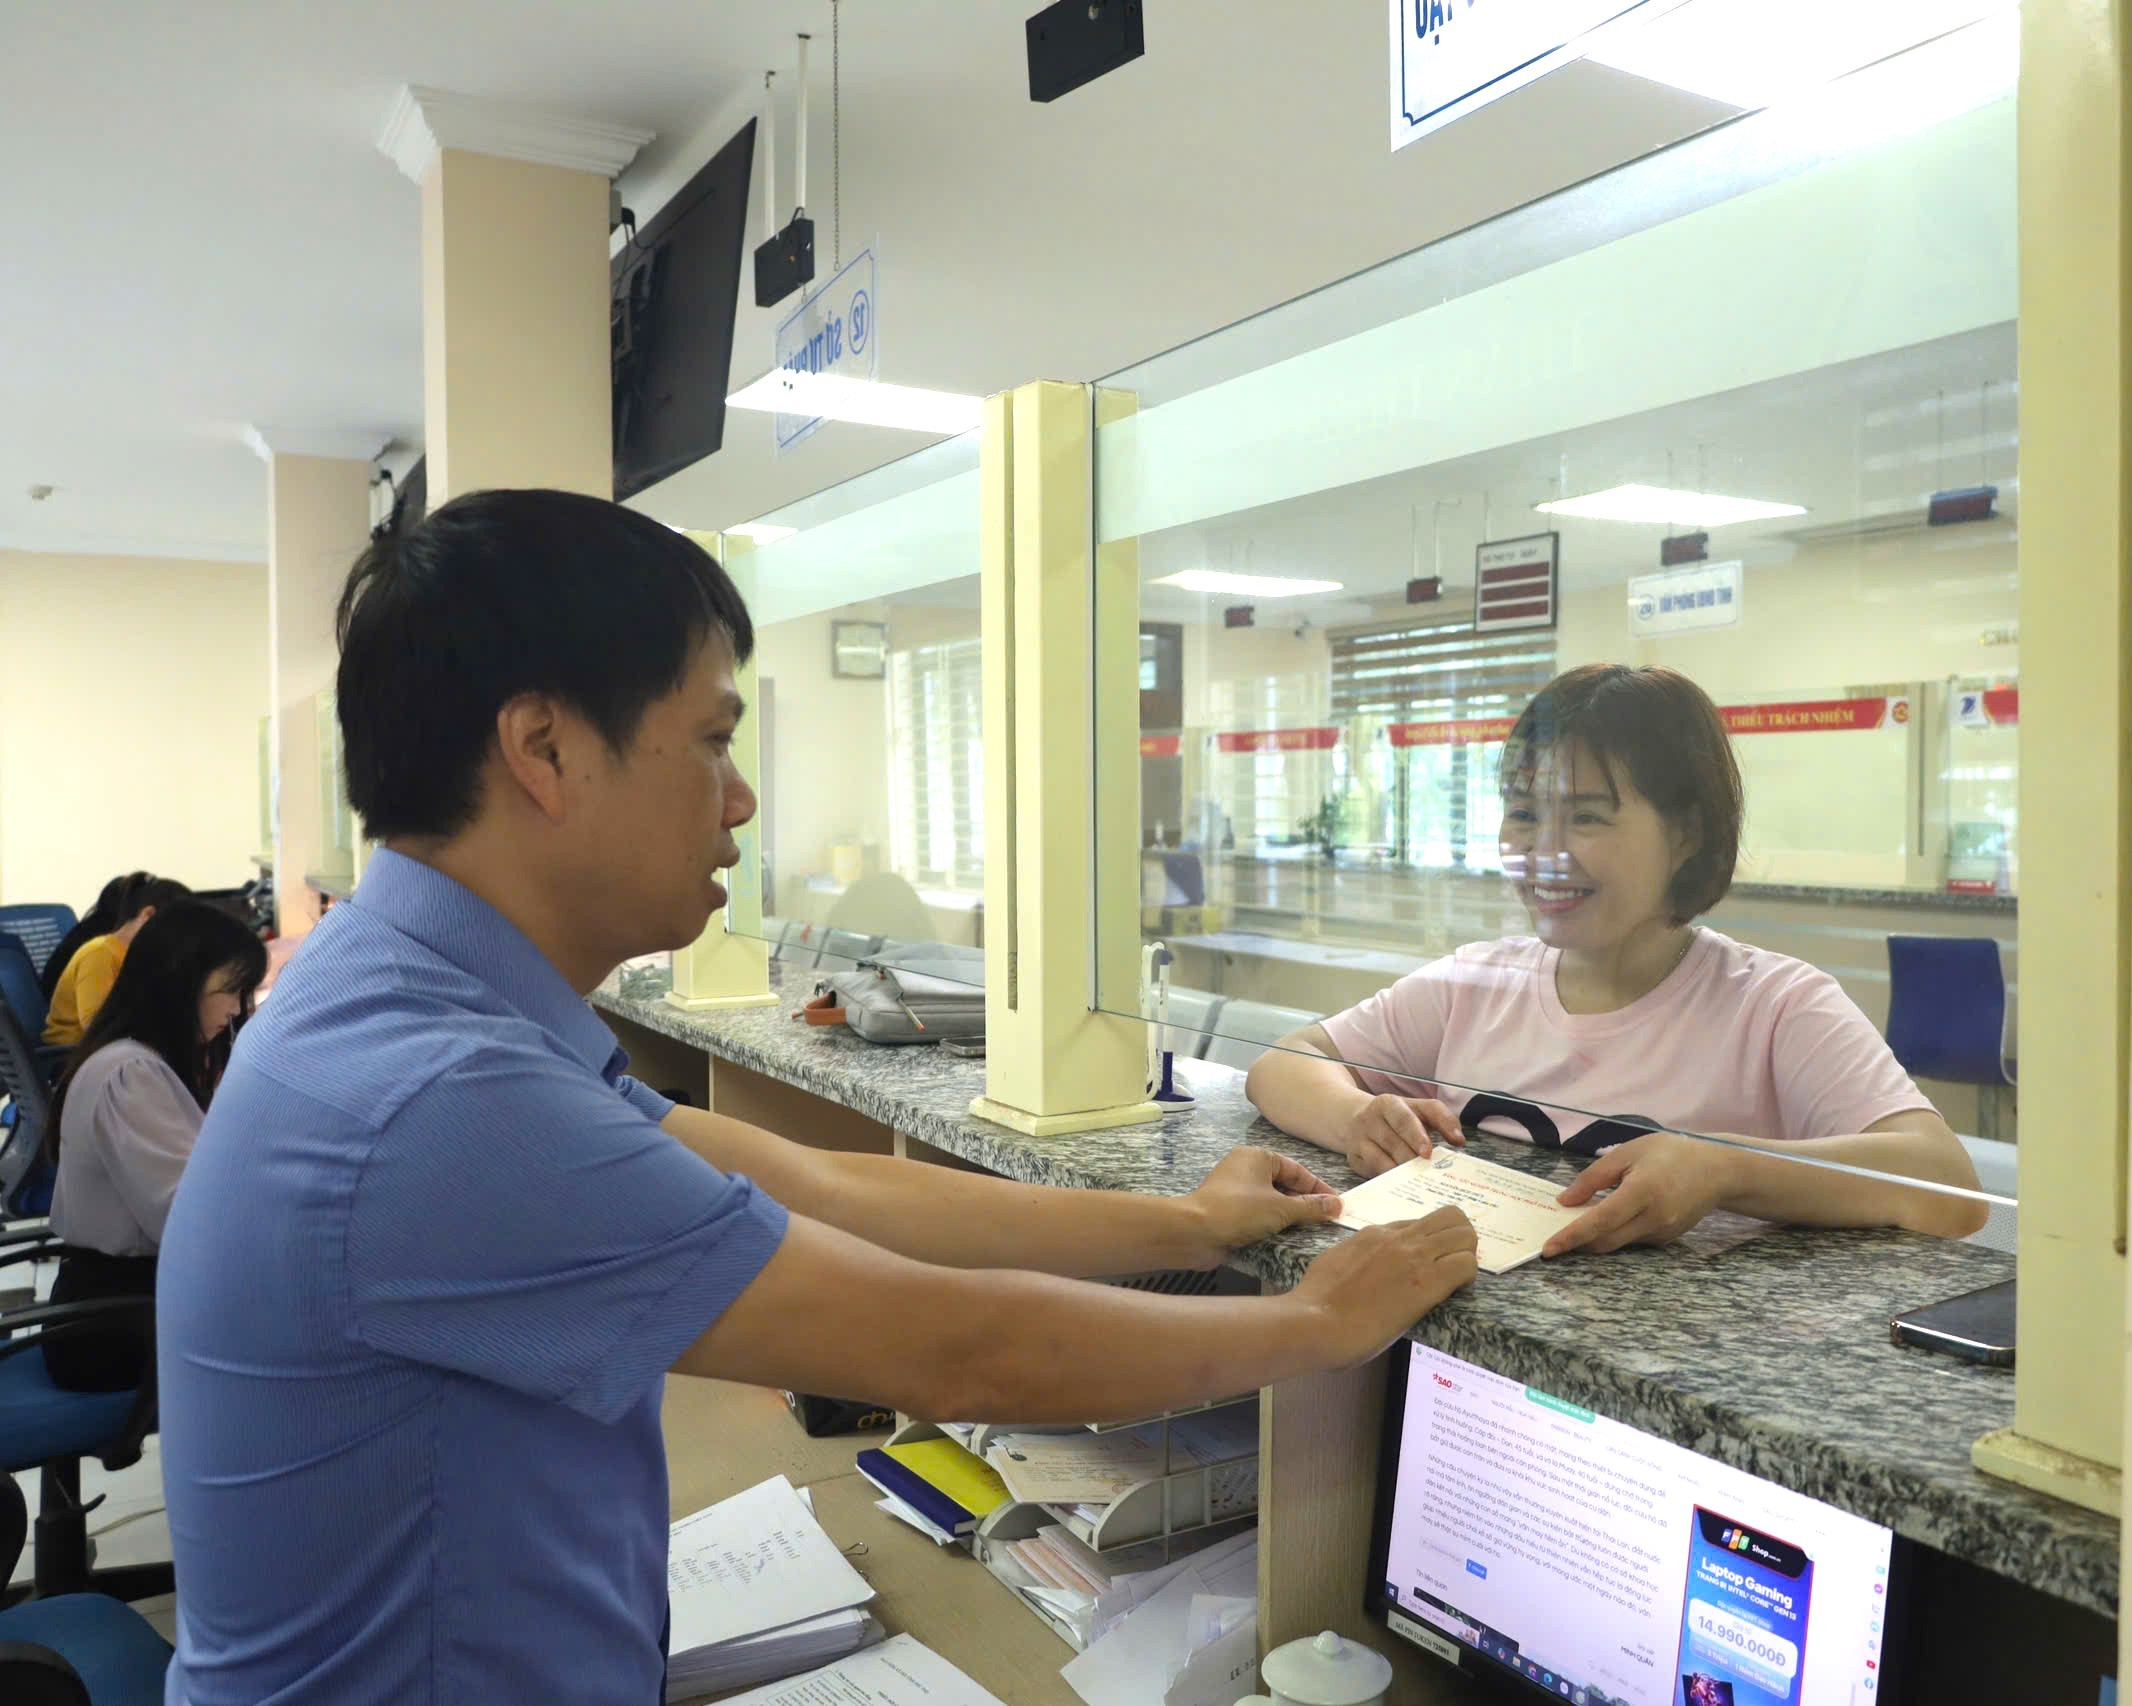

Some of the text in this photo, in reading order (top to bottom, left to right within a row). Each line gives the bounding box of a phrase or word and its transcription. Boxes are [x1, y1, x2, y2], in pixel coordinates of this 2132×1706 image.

[1721, 1528, 1750, 1551] FPT
[1701, 1556, 1793, 1609] Laptop Gaming
